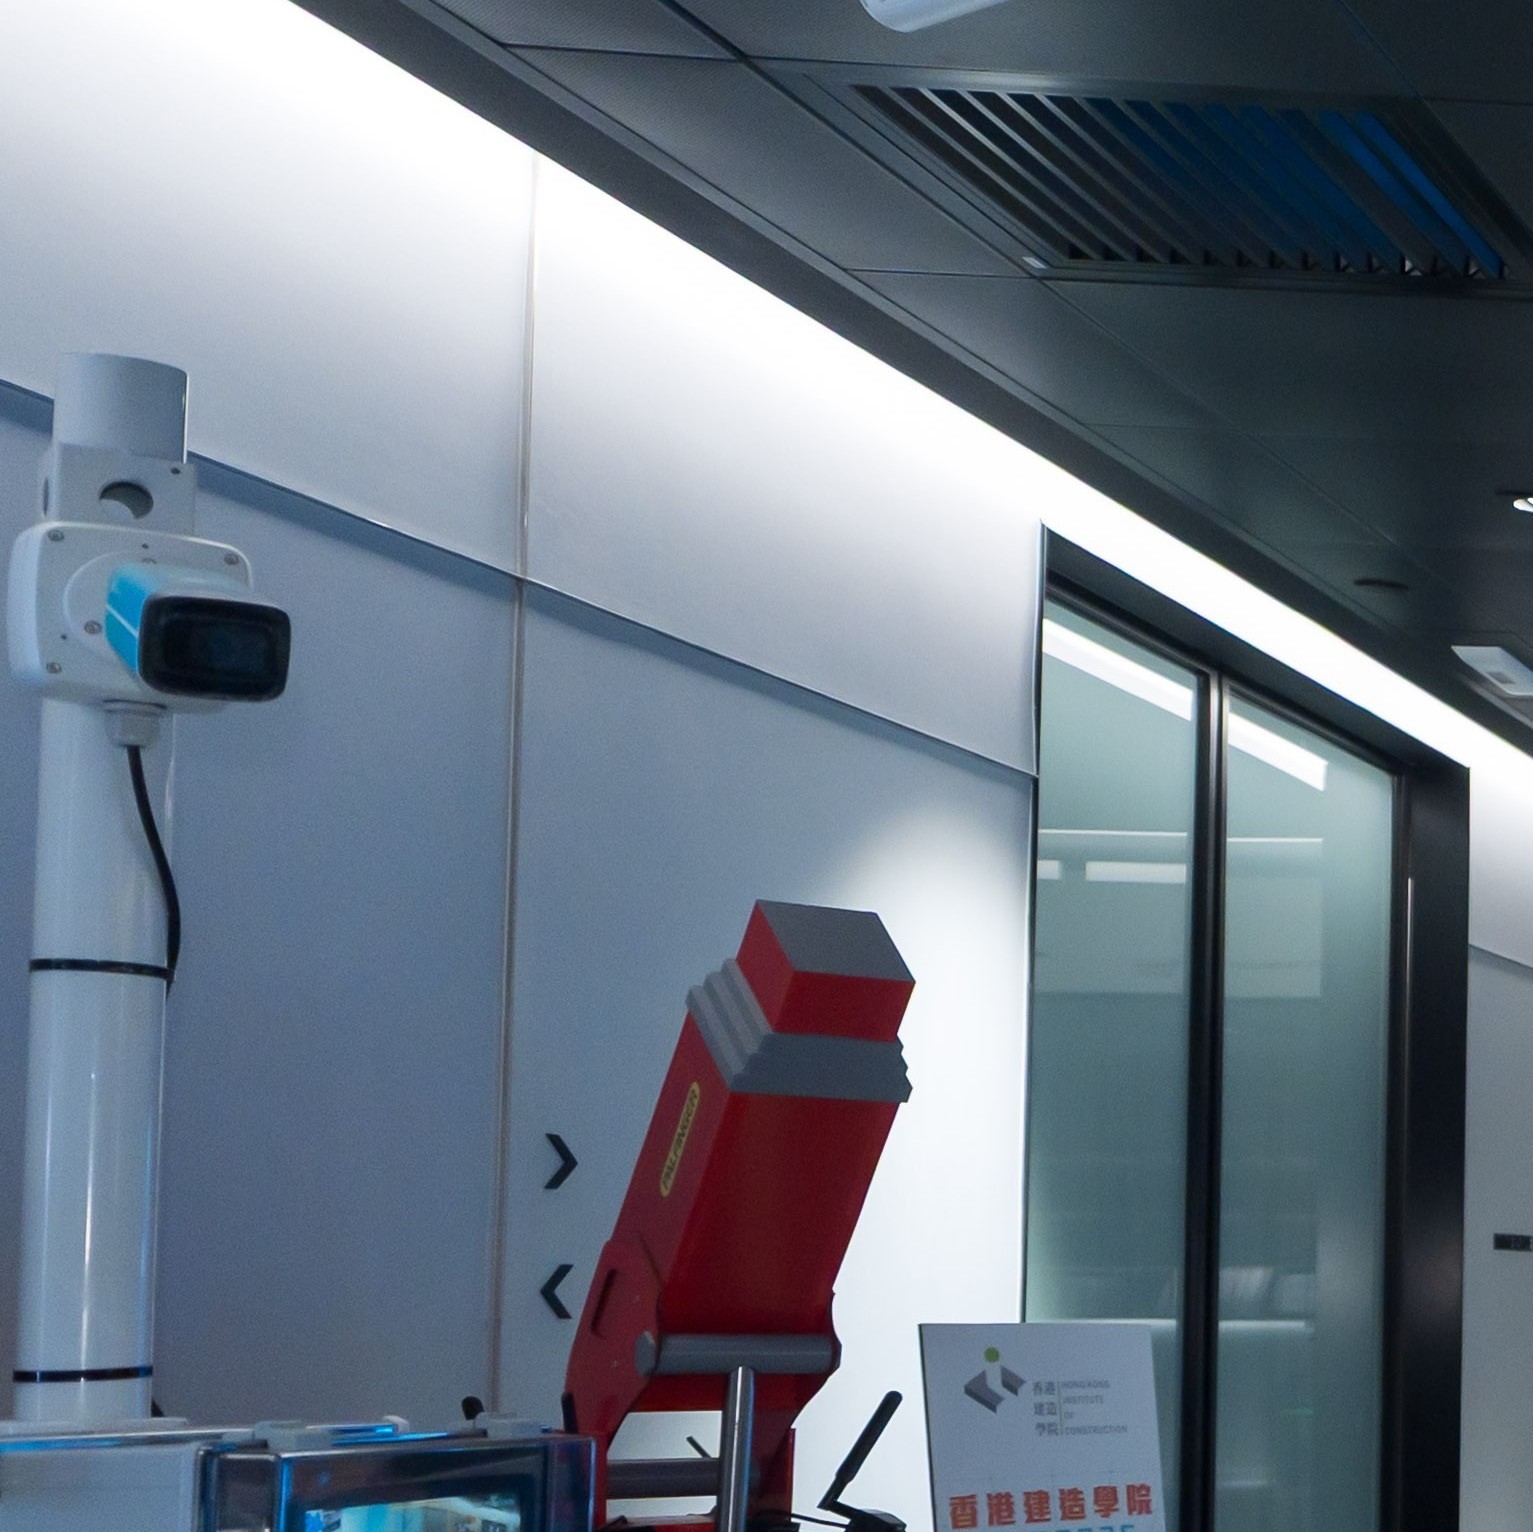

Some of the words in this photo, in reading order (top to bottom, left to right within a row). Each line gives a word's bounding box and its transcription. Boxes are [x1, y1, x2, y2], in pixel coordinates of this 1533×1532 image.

[949, 1483, 1153, 1530] 香港建造學院
